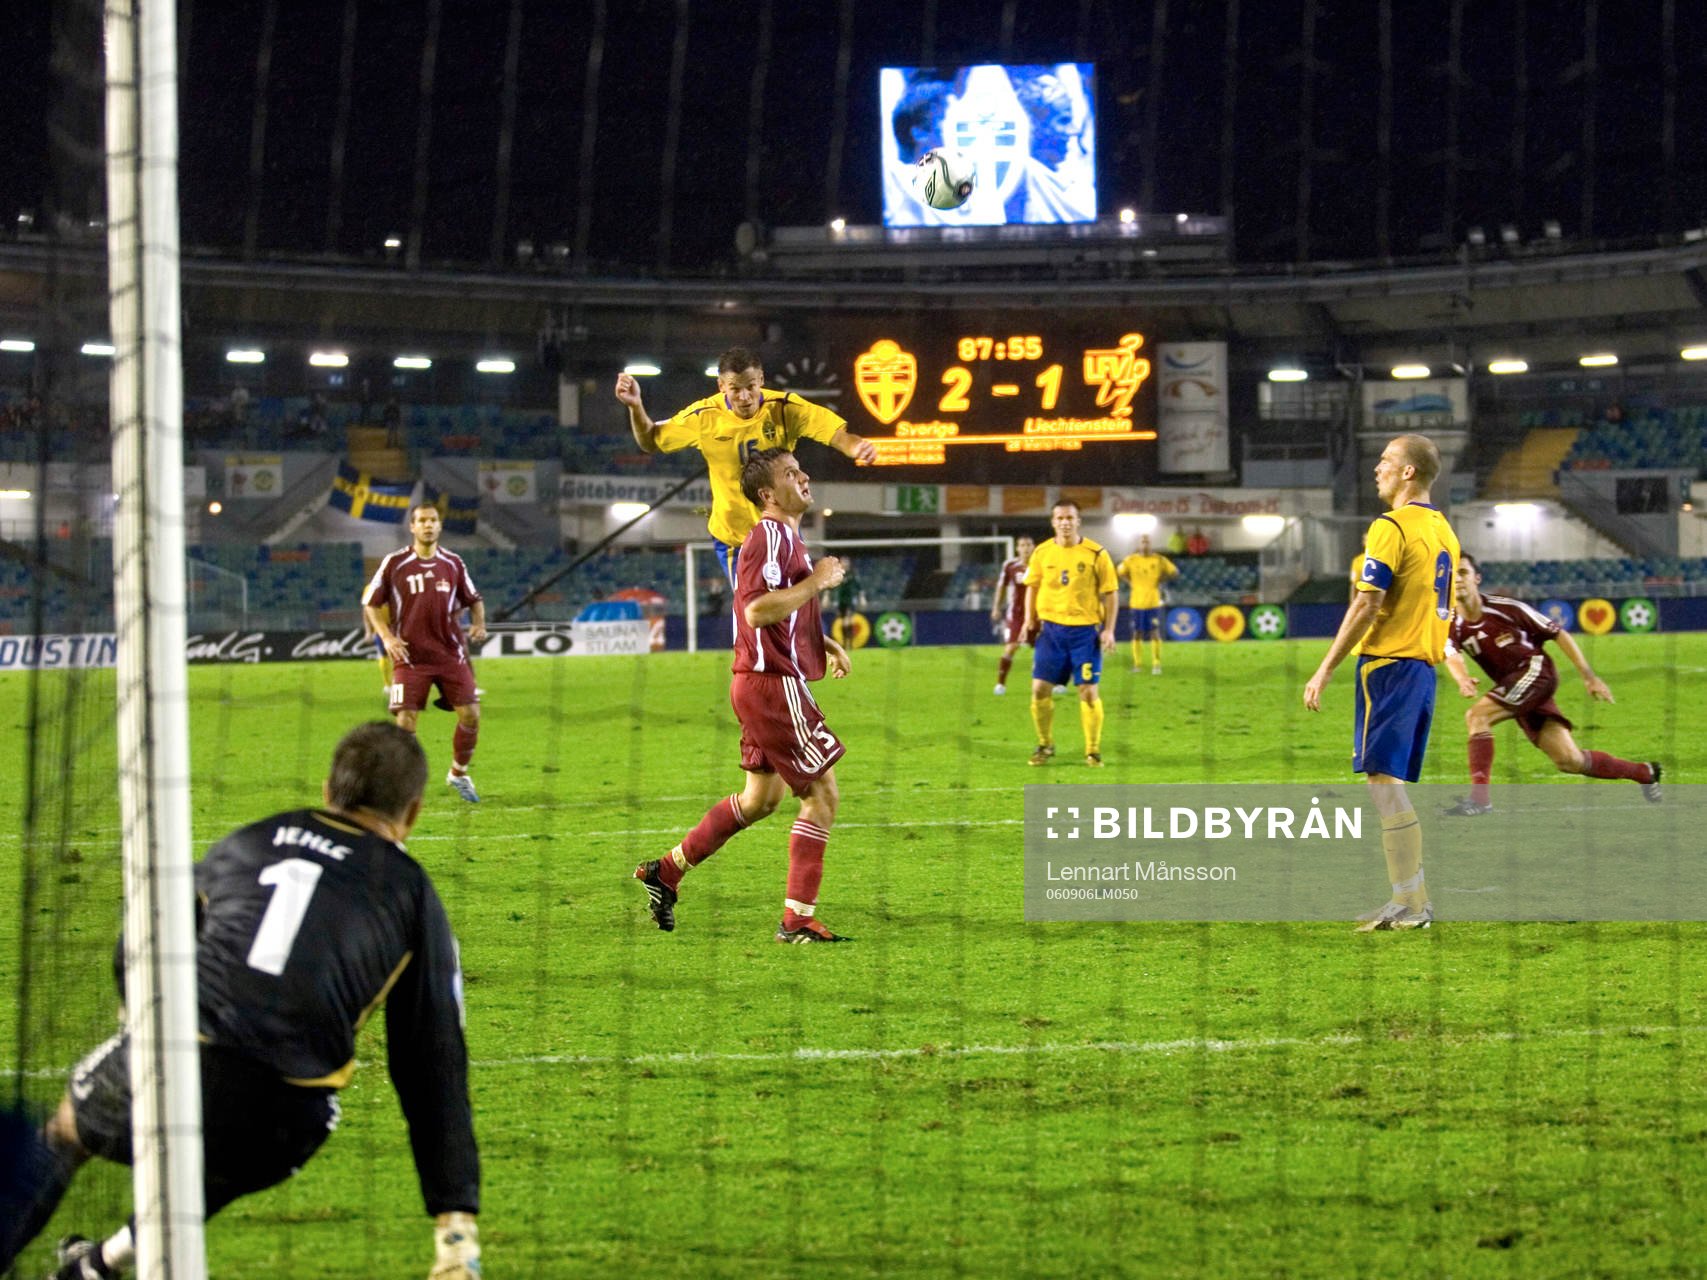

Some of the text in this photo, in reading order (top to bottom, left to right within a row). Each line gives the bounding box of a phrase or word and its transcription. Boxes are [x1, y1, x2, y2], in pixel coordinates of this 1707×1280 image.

[957, 336, 1043, 361] 87:55
[938, 366, 973, 412] 2
[1035, 364, 1063, 410] 1
[895, 421, 959, 438] Sverige
[1023, 416, 1133, 434] Liechtenstein
[1361, 559, 1377, 582] C
[406, 573, 424, 594] 11
[1434, 550, 1453, 620] 9
[1081, 663, 1093, 681] 6
[812, 721, 836, 750] 5
[272, 826, 353, 861] JEHLE
[247, 858, 324, 976] 1
